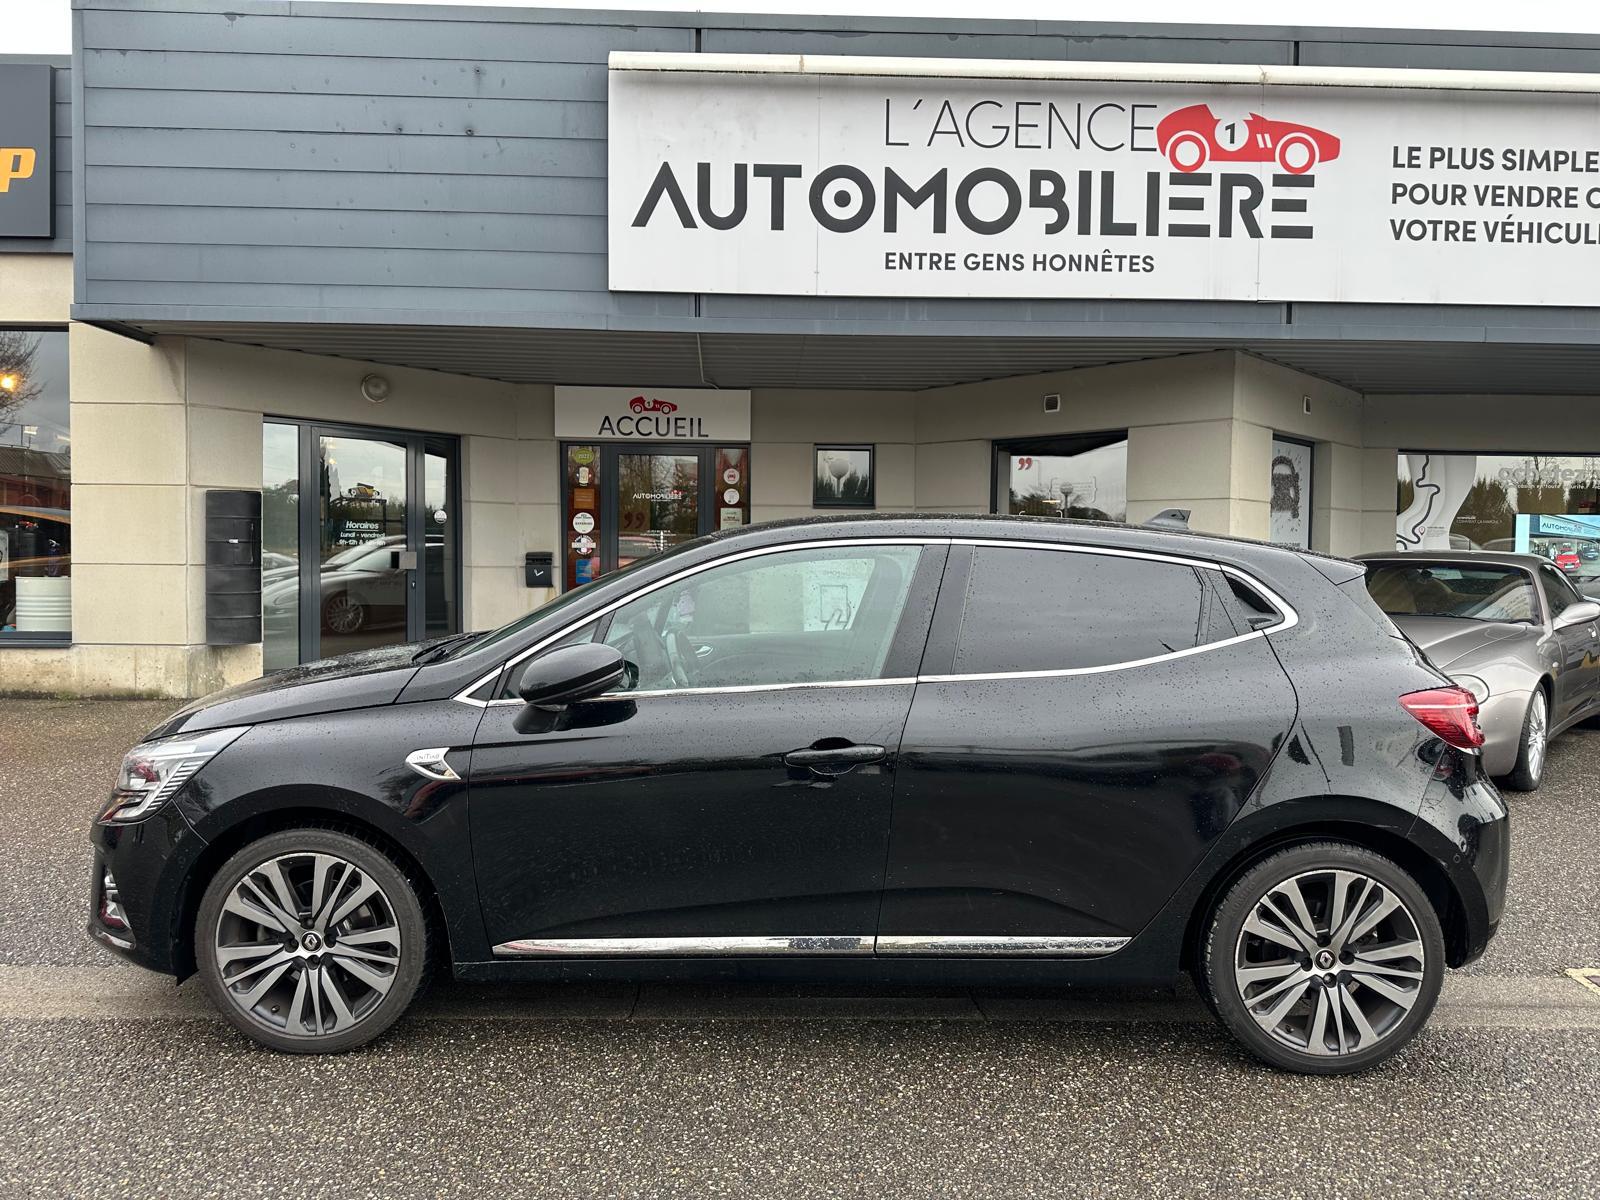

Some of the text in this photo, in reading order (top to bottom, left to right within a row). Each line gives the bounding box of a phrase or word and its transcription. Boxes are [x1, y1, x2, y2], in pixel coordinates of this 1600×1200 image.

[885, 98, 1158, 152] L'AGENCE
[1392, 145, 1599, 173] LE PLUS SIMPLE
[1391, 182, 1467, 206] POUR
[1473, 185, 1579, 208] VENDRE
[1389, 213, 1600, 245] VOTRE VÉHICUL
[884, 249, 1155, 273] ENTRE GENS HONNÊTES
[598, 415, 709, 438] ACCUEIL
[345, 521, 379, 531] Horaires
